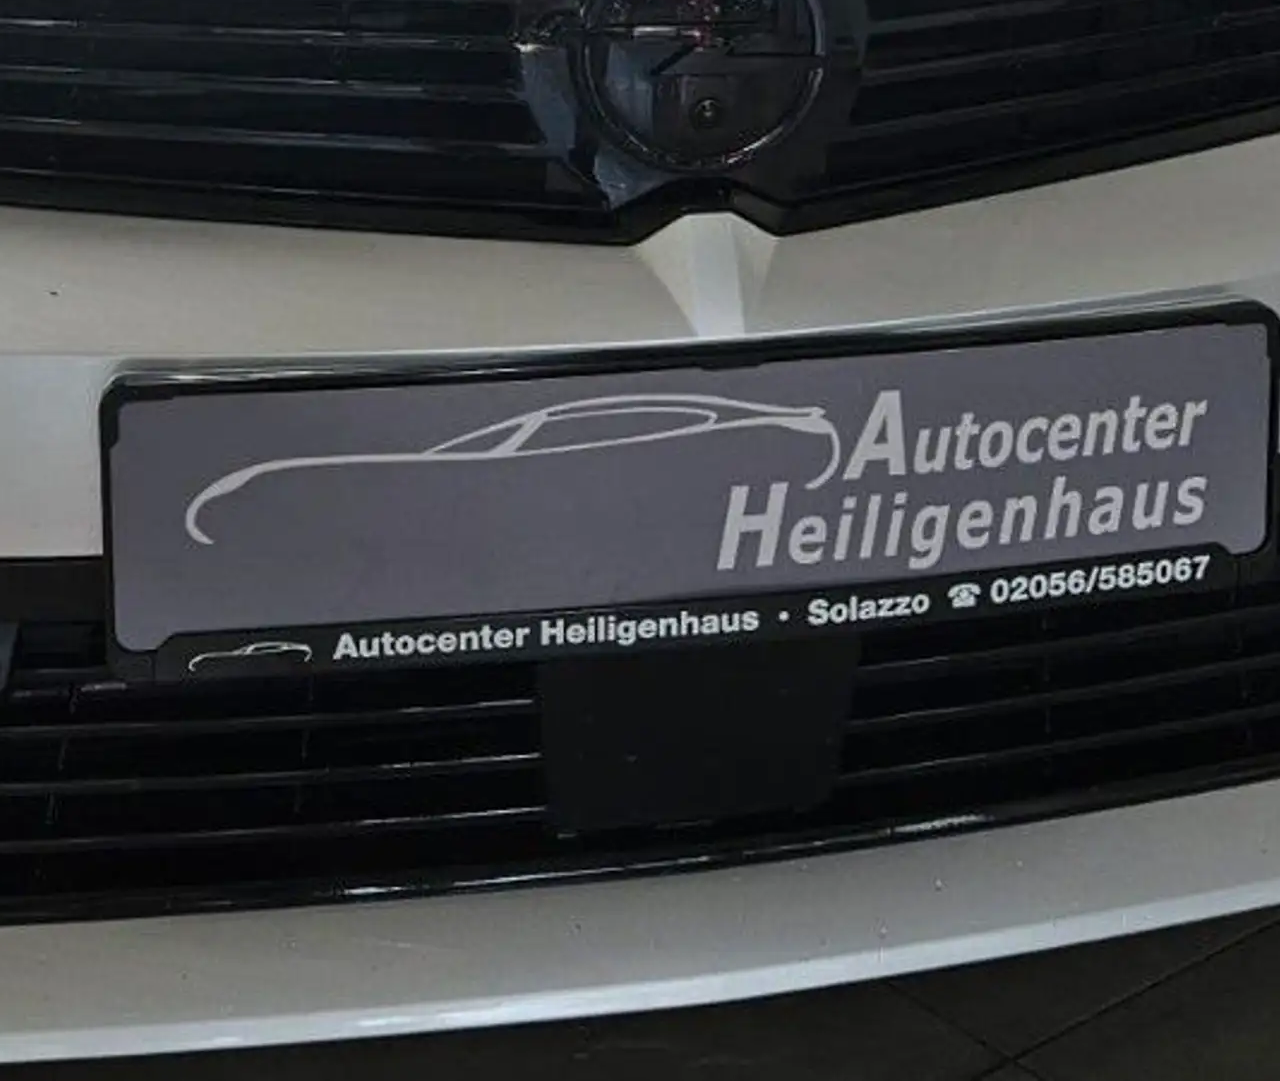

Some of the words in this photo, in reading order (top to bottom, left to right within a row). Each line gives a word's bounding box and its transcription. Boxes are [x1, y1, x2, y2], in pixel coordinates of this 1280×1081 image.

[841, 389, 1208, 481] Autocenter
[716, 475, 1208, 570] Heiligenhaus
[332, 624, 531, 661] Autocenter
[540, 609, 760, 646] Heiligenhaus
[807, 592, 931, 627] Solazzo
[989, 554, 1211, 604] 02056/585067
